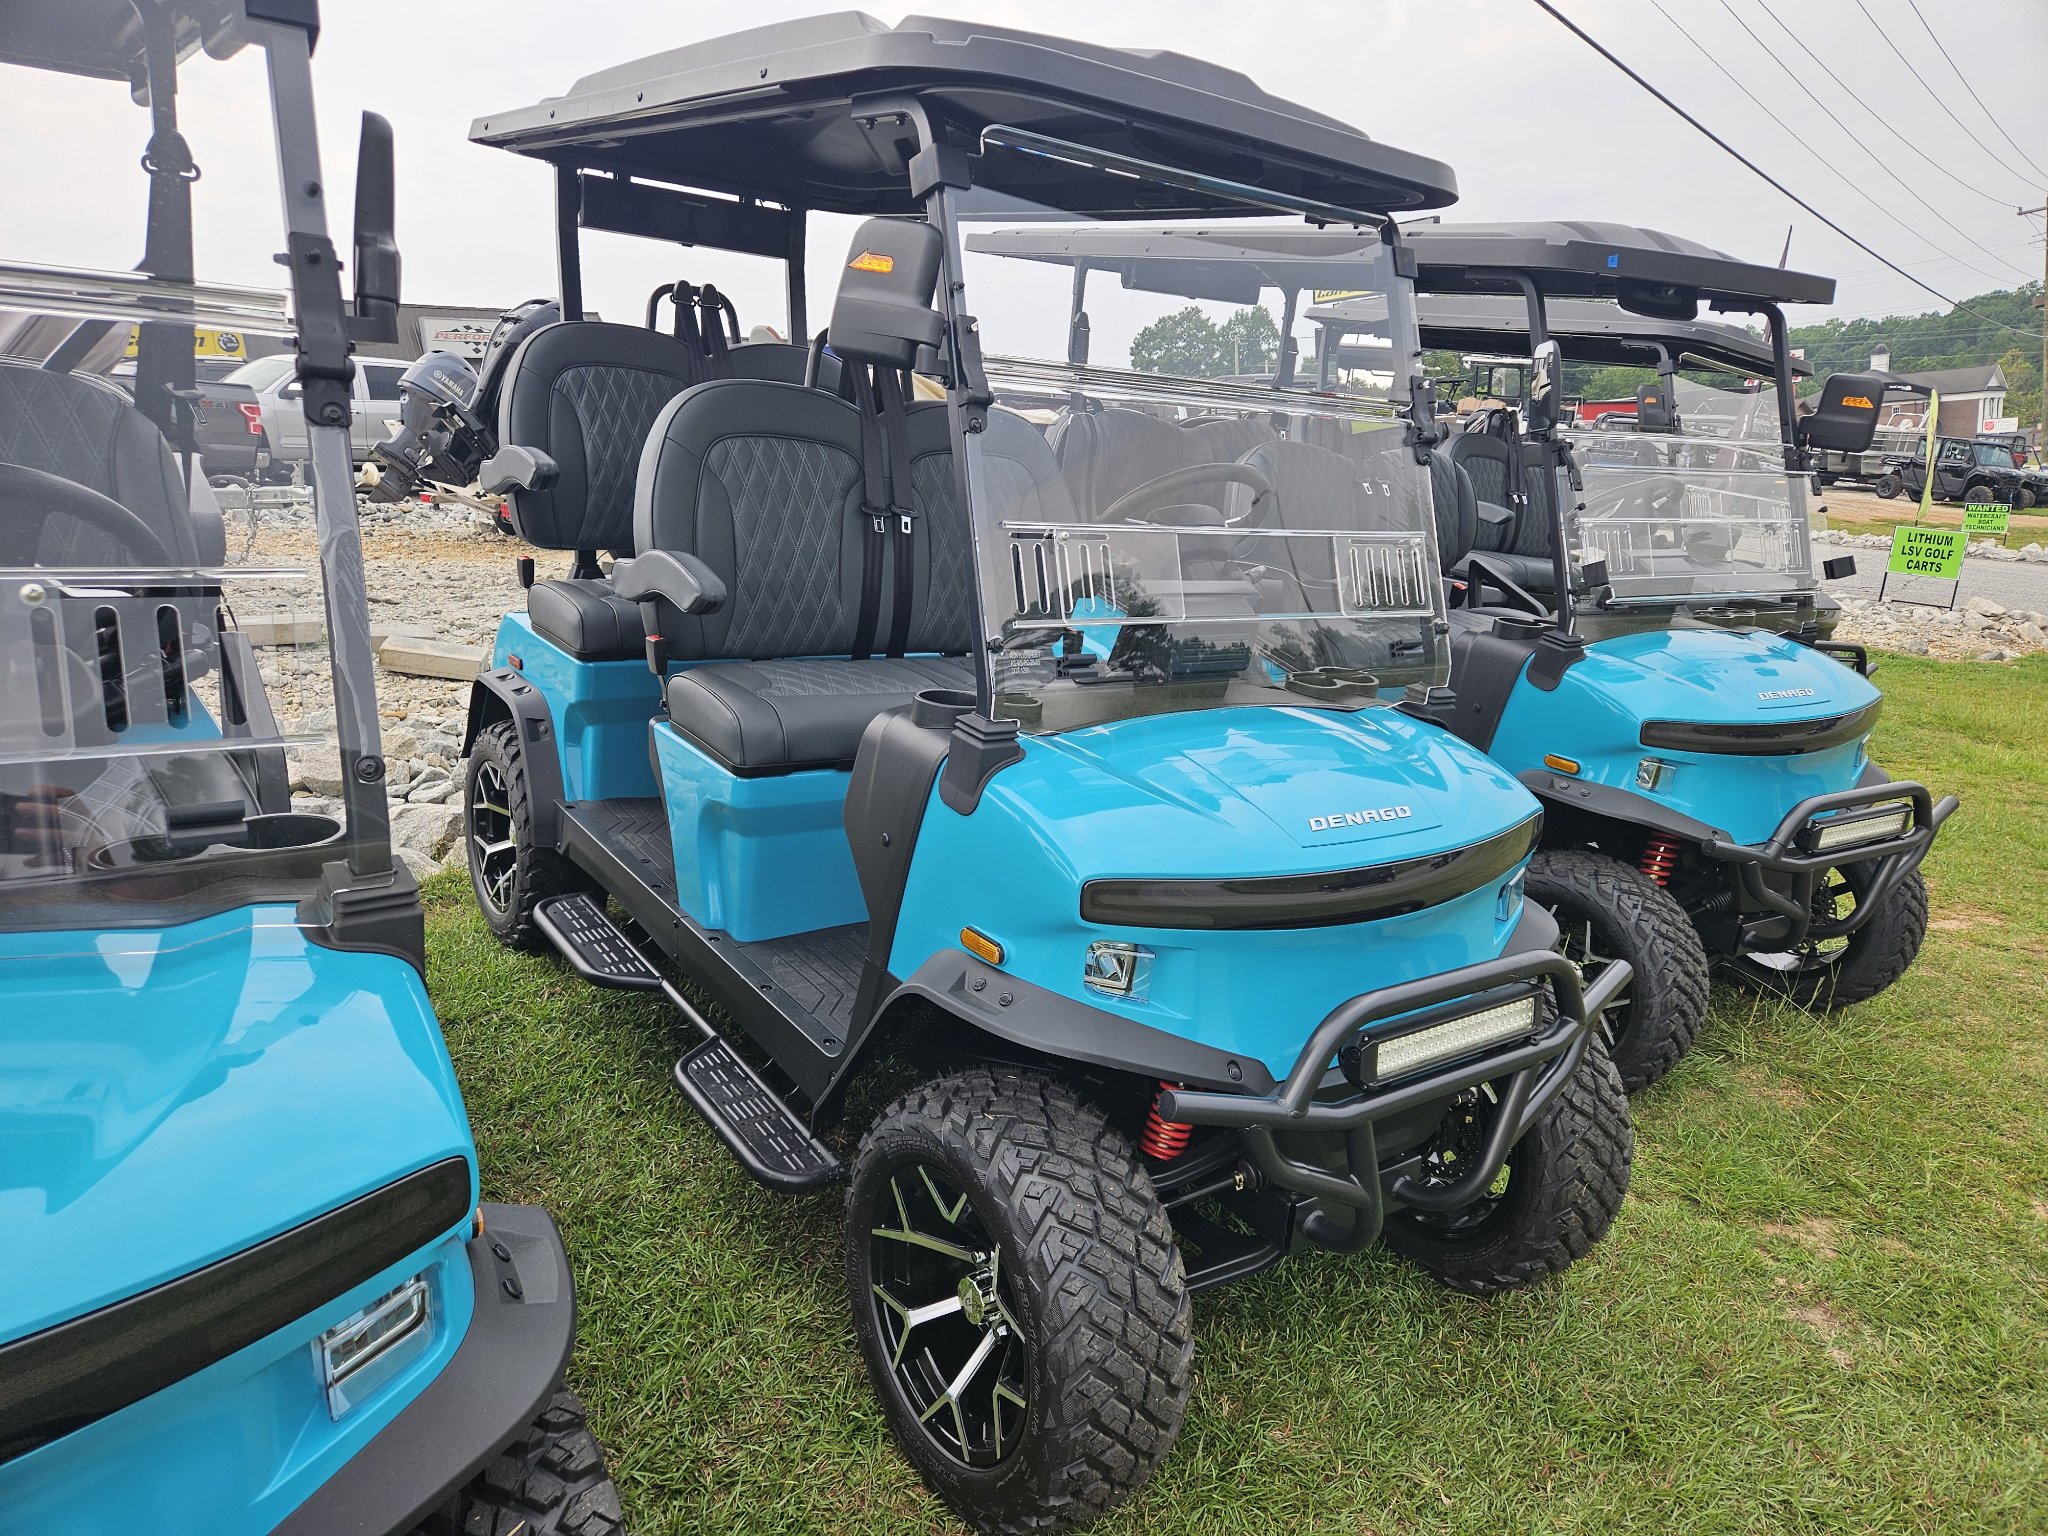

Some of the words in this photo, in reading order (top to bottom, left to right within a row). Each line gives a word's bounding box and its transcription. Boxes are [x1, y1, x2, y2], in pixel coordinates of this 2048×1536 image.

[441, 374, 464, 397] YAMAHA
[1968, 504, 2009, 512] WANTED
[1907, 532, 1954, 546] LITHIUM
[1901, 545, 1922, 556] LSV
[1924, 548, 1954, 560] GOLF
[1906, 559, 1942, 573] CARTS
[1757, 688, 1816, 701] DENAGO
[1309, 805, 1412, 832] DENAGO
